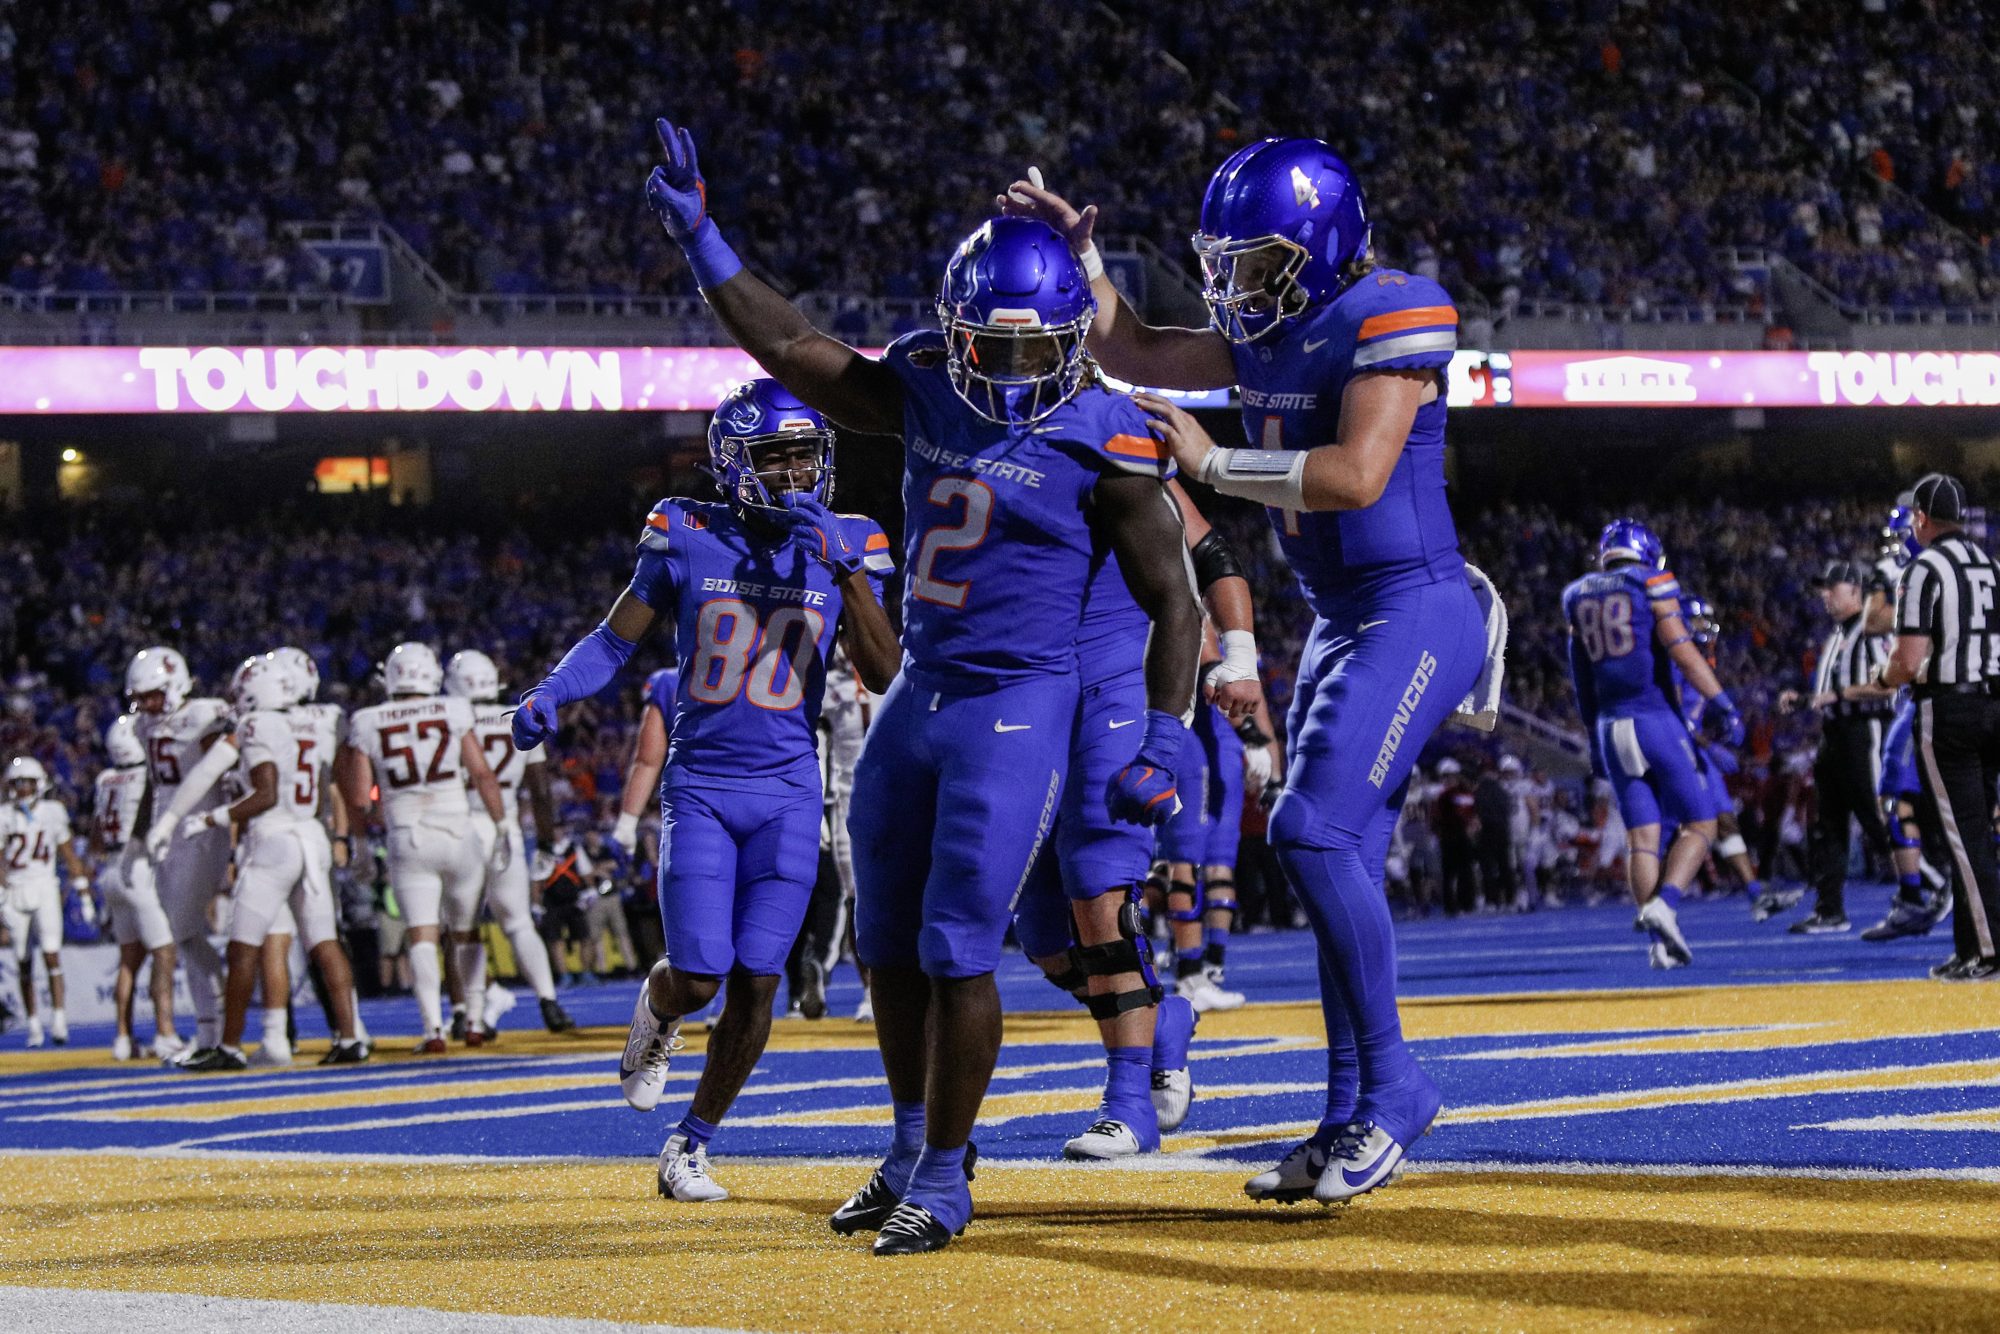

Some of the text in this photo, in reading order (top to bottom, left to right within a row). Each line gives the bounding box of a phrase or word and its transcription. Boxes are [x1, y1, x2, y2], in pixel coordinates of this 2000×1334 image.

[139, 347, 622, 411] TOUCHDOWN
[1267, 394, 1317, 410] STATE
[1808, 351, 2000, 405] TOUCHD
[911, 437, 1046, 489] BOISE STATE
[912, 472, 996, 609] 2
[700, 577, 828, 606] BOISE STATE
[1965, 567, 1997, 630] F
[688, 598, 825, 712] 80
[1576, 592, 1636, 663] 88
[1367, 650, 1438, 790] BRONCOS
[294, 738, 317, 805] 5
[378, 719, 456, 788] 52
[8, 831, 50, 869] 24
